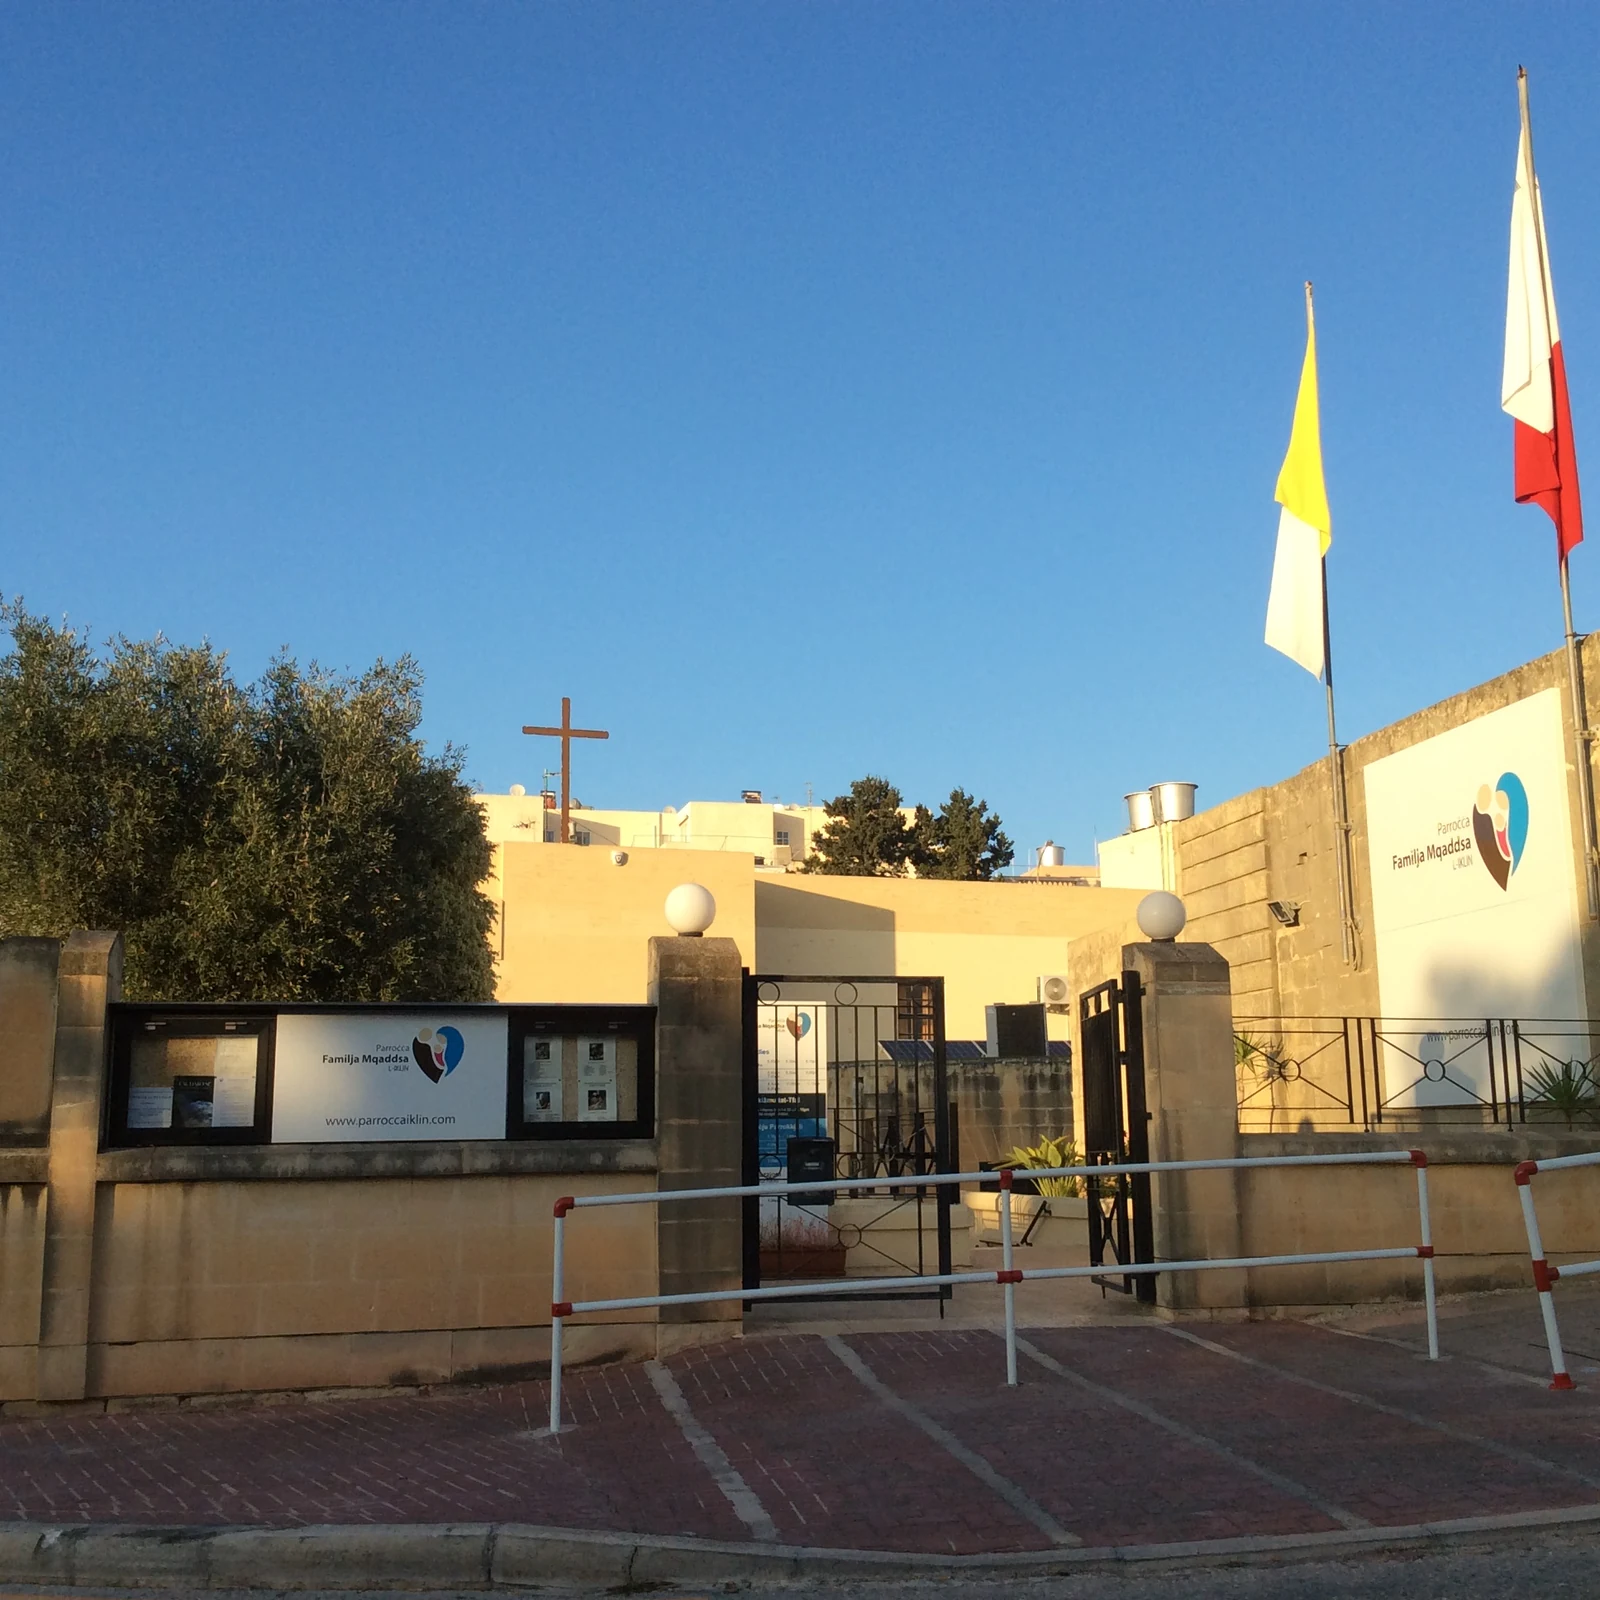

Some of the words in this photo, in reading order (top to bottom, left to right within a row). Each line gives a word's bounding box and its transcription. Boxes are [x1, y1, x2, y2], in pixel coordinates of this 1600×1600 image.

[1392, 848, 1425, 870] Familja
[1427, 836, 1471, 861] Mqaddsa
[322, 1054, 360, 1065] Familja
[362, 1054, 409, 1065] Mqaddsa
[325, 1114, 456, 1127] www.parroccaiklin.com
